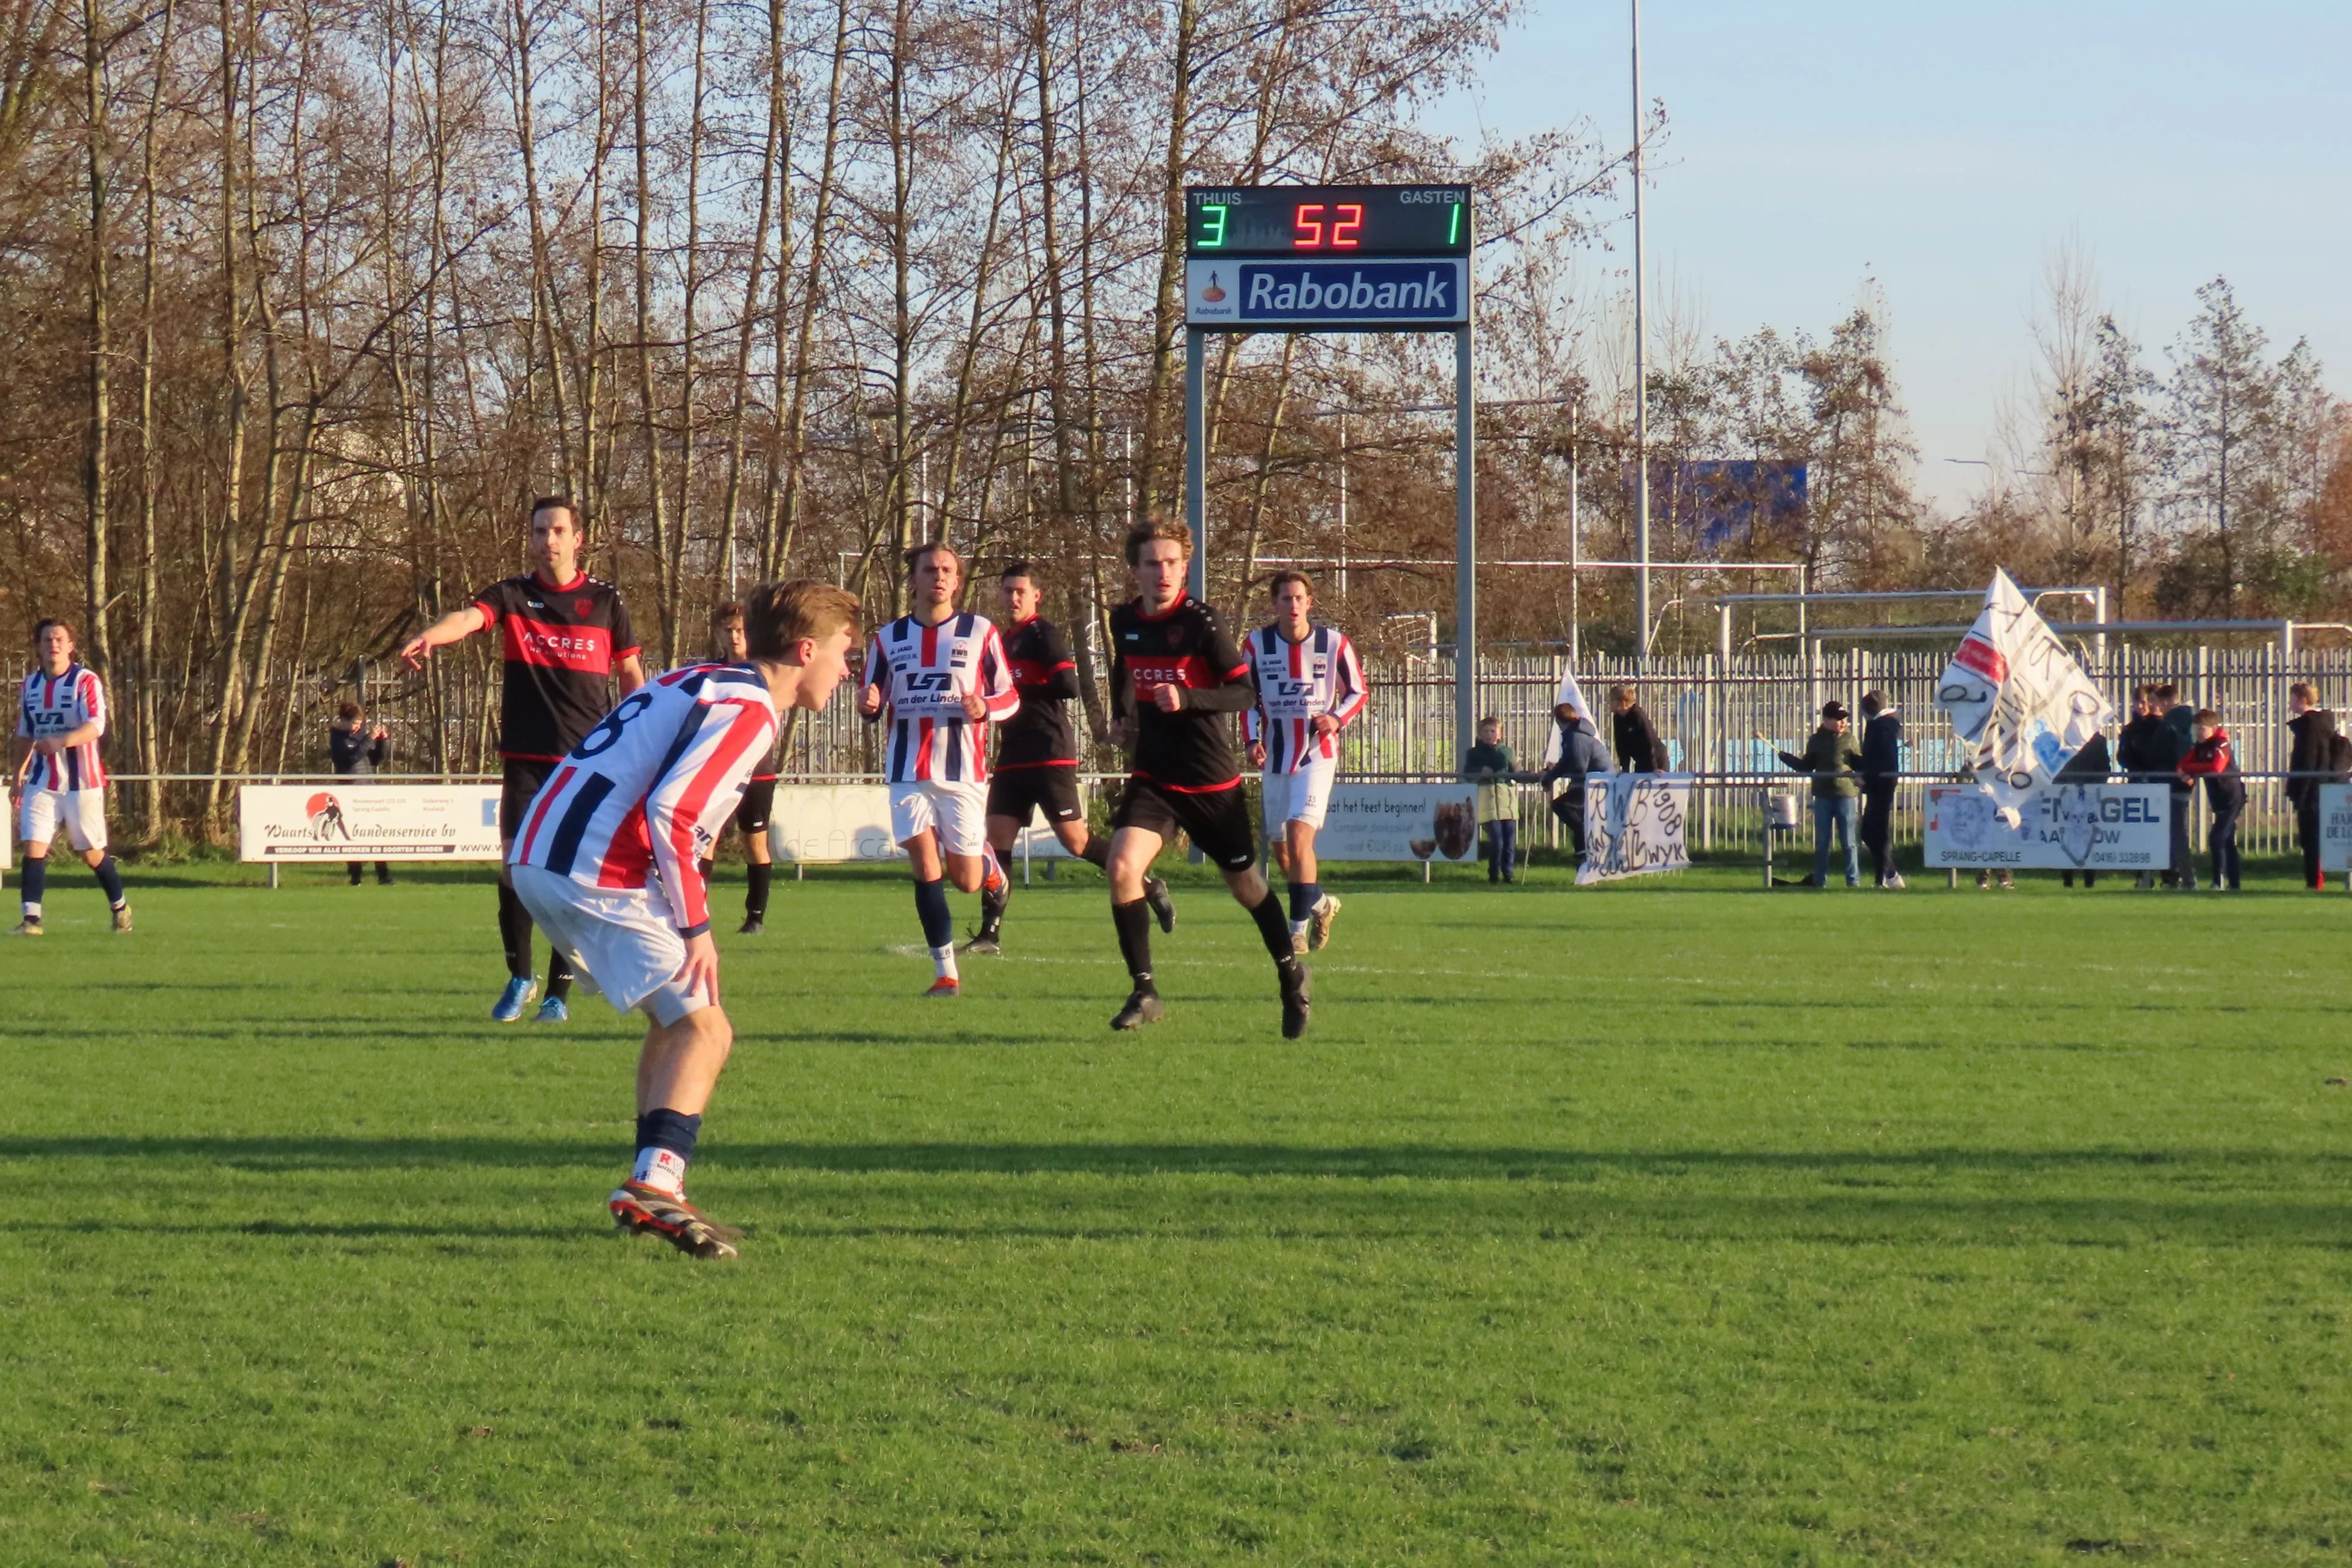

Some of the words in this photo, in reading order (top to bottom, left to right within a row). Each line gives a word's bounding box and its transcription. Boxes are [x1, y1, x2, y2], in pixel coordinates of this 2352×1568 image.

[1193, 192, 1242, 205] THUIS
[1400, 190, 1466, 204] GASTEN
[1197, 205, 1226, 246] 3
[1293, 204, 1363, 246] 52
[1449, 203, 1460, 244] 1
[1248, 271, 1449, 310] Rabobank
[522, 632, 595, 652] ACCRES
[1133, 668, 1186, 680] CCRES
[911, 695, 927, 704] der
[930, 693, 963, 703] Linde
[571, 692, 653, 760] 8
[1343, 797, 1358, 813] het
[1361, 797, 1381, 813] feest
[1384, 797, 1426, 817] beginnen!
[352, 824, 437, 837] bandenservice
[442, 824, 456, 837] bv
[785, 829, 819, 858] de
[829, 829, 908, 858] Arca
[1942, 851, 2021, 862] SPRANG-CAPELLE
